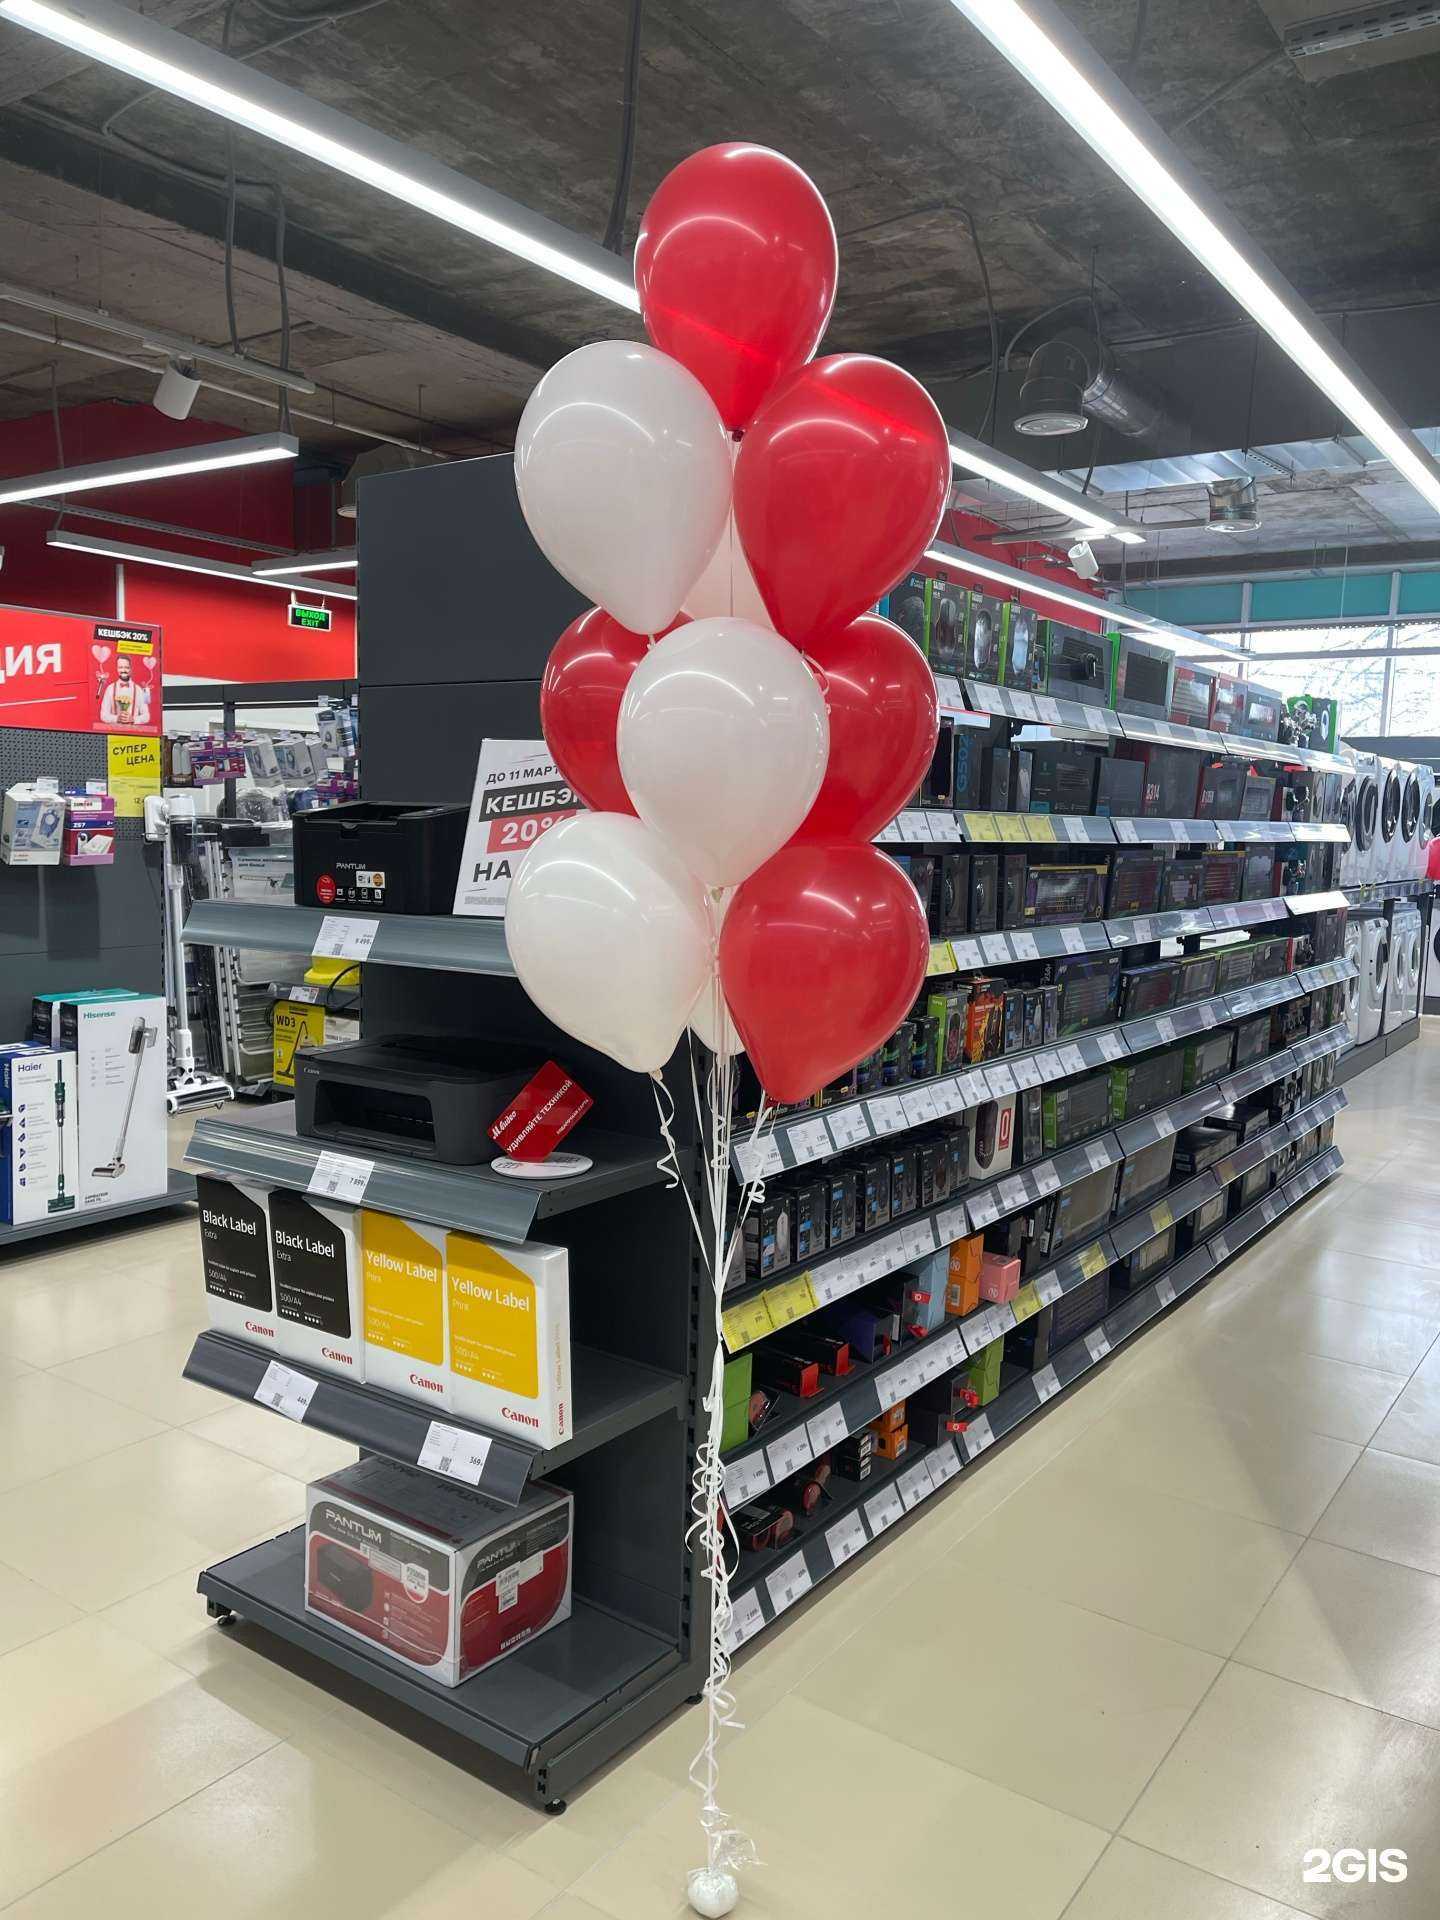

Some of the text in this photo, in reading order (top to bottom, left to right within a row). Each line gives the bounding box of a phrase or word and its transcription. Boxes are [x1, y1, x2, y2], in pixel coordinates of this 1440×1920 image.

[295, 608, 326, 621] ВЫХОД
[301, 618, 319, 627] EXIT
[97, 628, 148, 641] КЕШБЭК 20%
[0, 643, 61, 684] ИЯ
[112, 743, 148, 756] СУПЕР
[126, 754, 155, 766] ЦЕНА
[486, 772, 506, 785] ДО
[510, 770, 520, 780] 11
[485, 788, 582, 815] КЕШБЭ
[336, 862, 366, 870] PANTUM
[473, 859, 512, 883] НА
[83, 1010, 117, 1020] Hisense
[276, 1015, 296, 1028] WD3
[17, 1063, 43, 1073] Haier
[506, 1079, 573, 1153] УДИВЛЯЙТЕ ТЕХНИКОЙ
[203, 1209, 256, 1236] Black Label
[204, 1229, 217, 1240] Extra
[275, 1230, 335, 1258] Black Label
[276, 1250, 292, 1262] Extra
[366, 1249, 438, 1283] Yellow Label
[452, 1276, 530, 1312] Yellow Label
[245, 1321, 275, 1338] Canon
[321, 1346, 353, 1366] Canon
[409, 1373, 444, 1394] Canon
[501, 1407, 539, 1428] Canon
[325, 1509, 382, 1544] PANTUM
